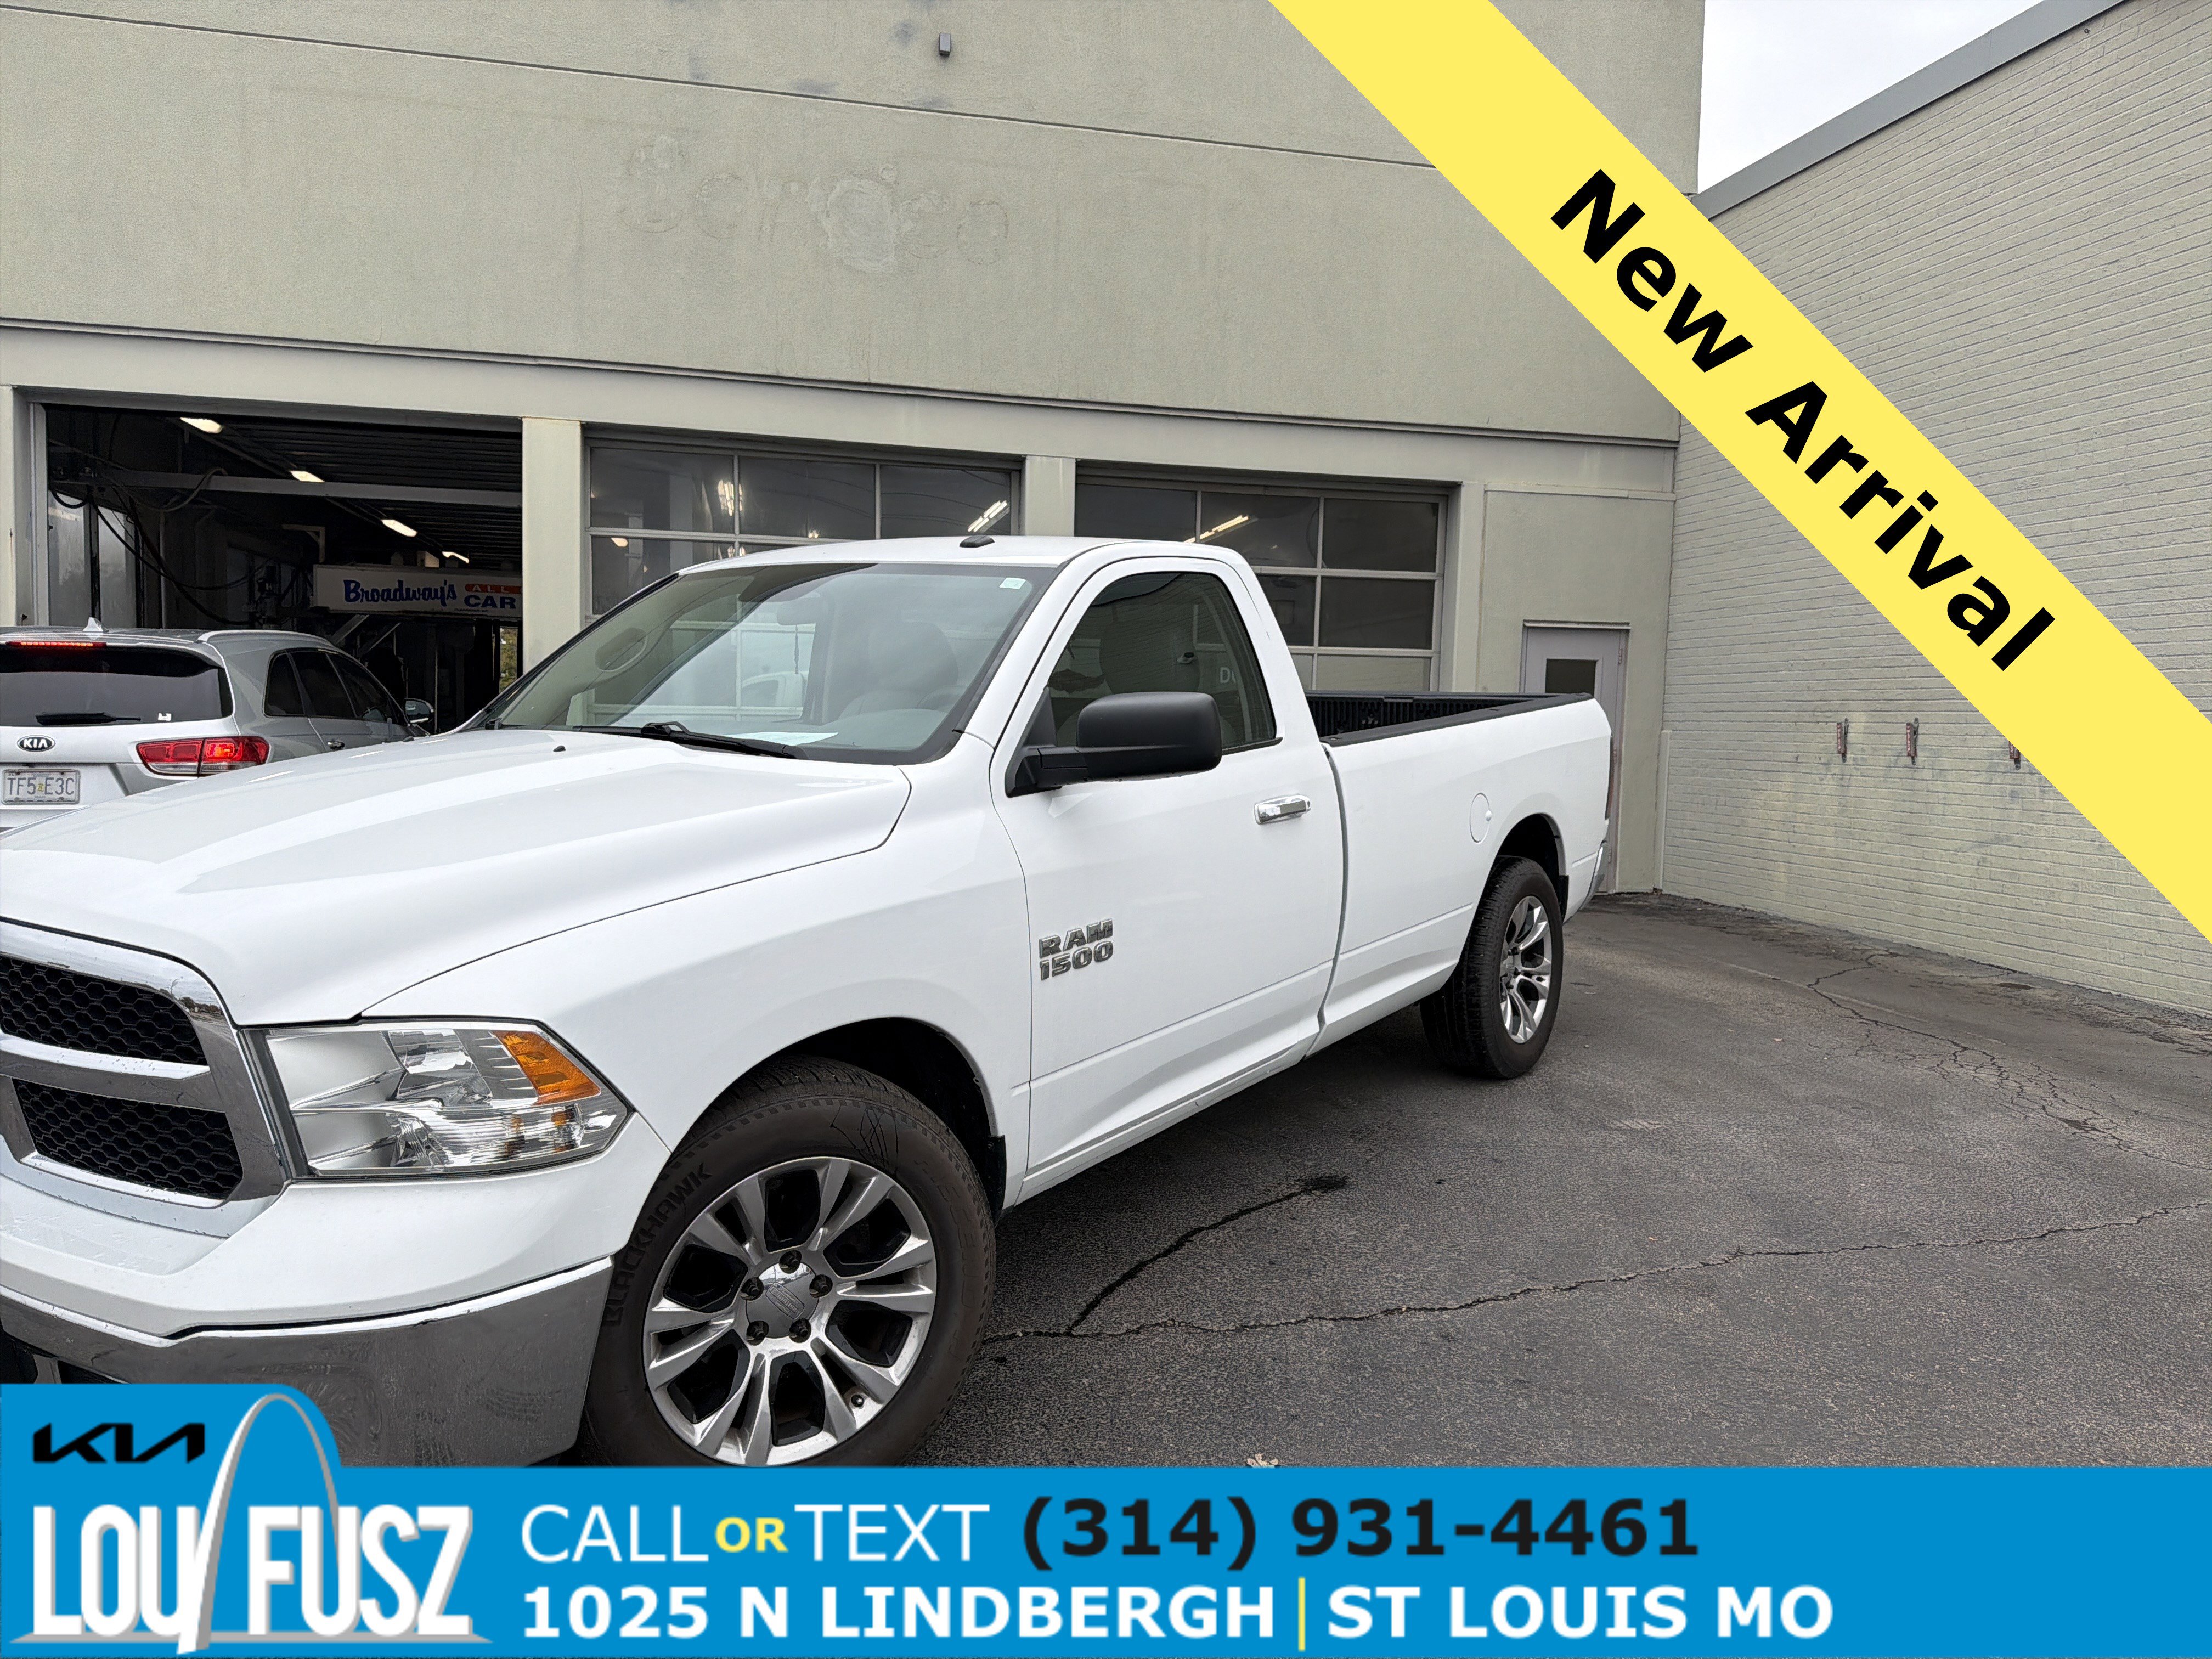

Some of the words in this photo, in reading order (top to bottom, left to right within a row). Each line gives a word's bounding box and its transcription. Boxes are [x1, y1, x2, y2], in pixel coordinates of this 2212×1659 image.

[343, 579, 457, 606] Broadway's
[464, 595, 516, 609] CAR
[23, 738, 48, 748] KIA
[7, 777, 37, 795] TF5
[44, 777, 75, 795] E3C
[1039, 918, 1113, 959] RAM
[1039, 940, 1114, 981] 1500
[604, 1162, 713, 1327] BLACKHAWK
